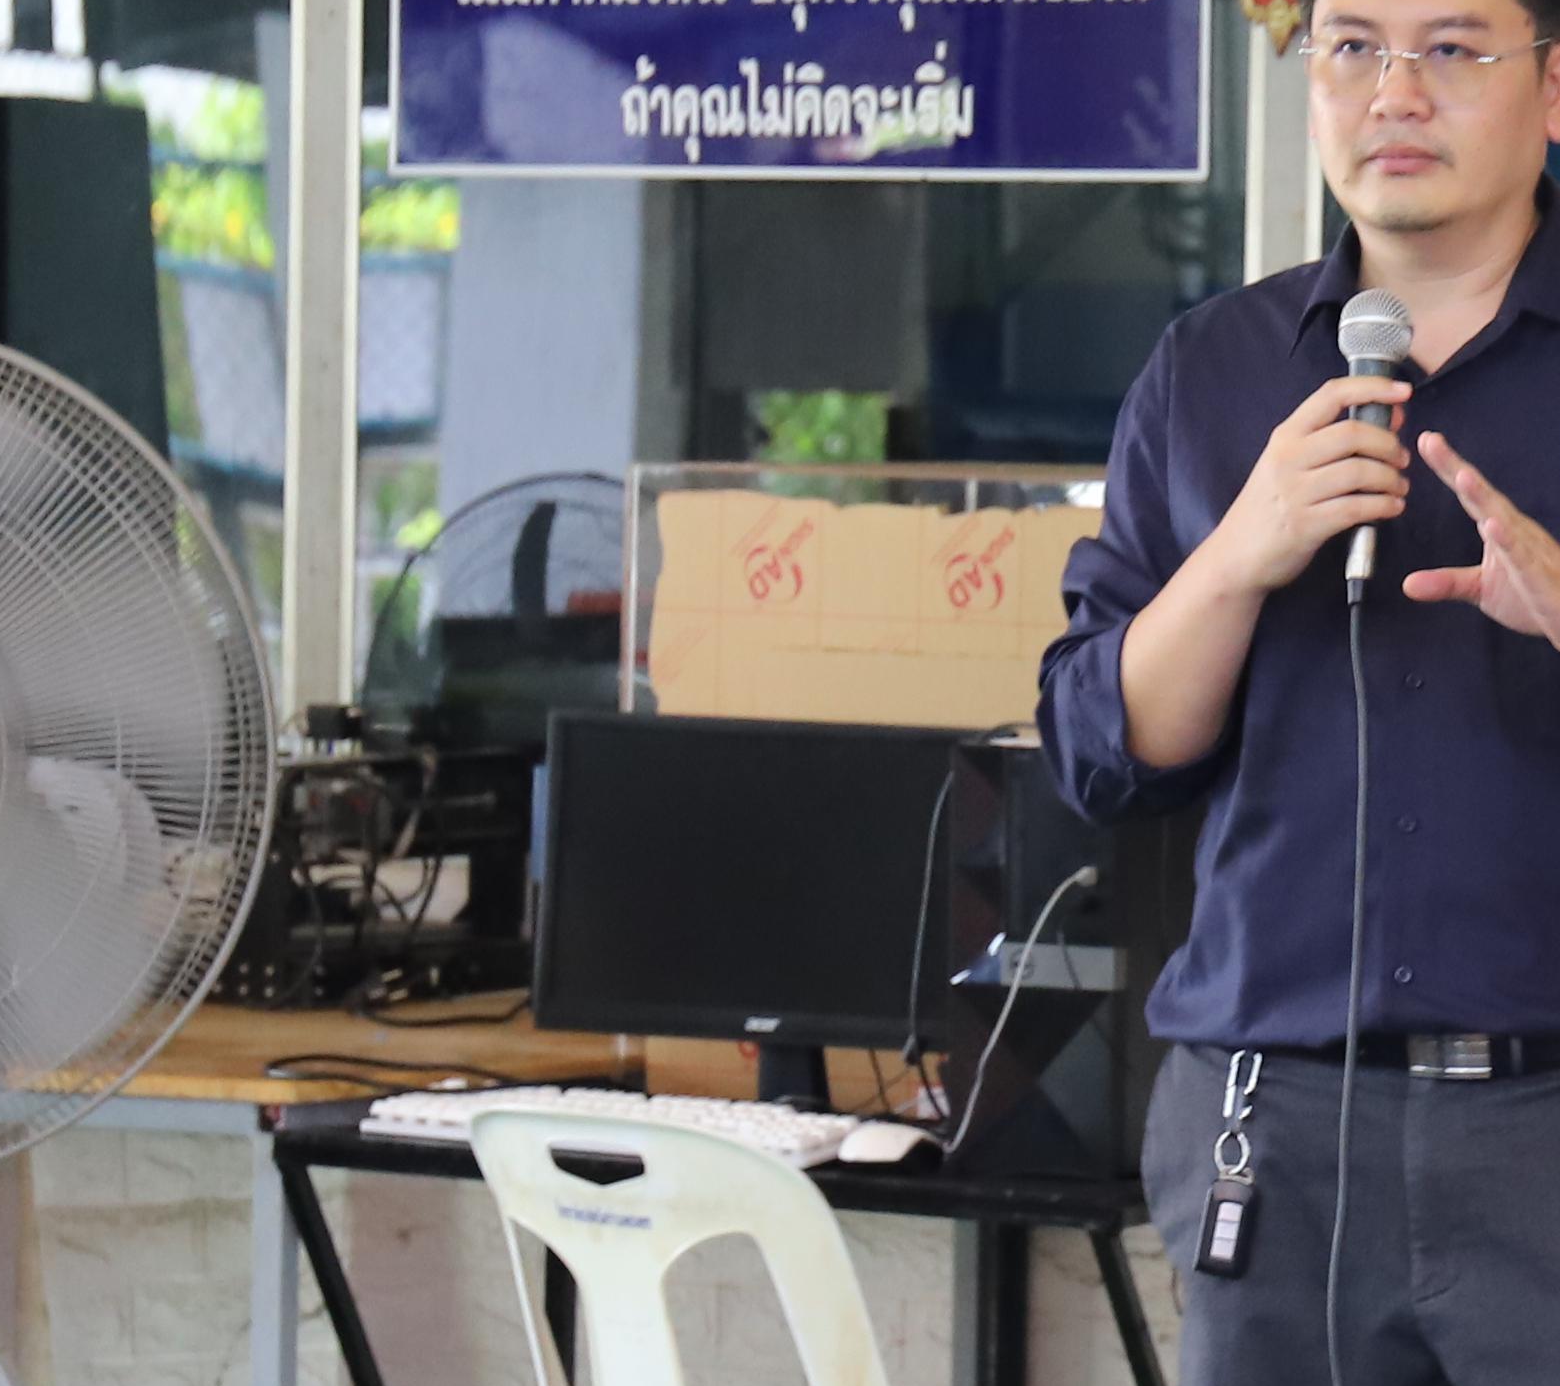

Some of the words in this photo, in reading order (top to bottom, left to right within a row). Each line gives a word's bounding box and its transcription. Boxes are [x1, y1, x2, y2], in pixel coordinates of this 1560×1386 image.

[621, 42, 973, 163] ถ้าคุณไม่คิดจะเริ่ม
